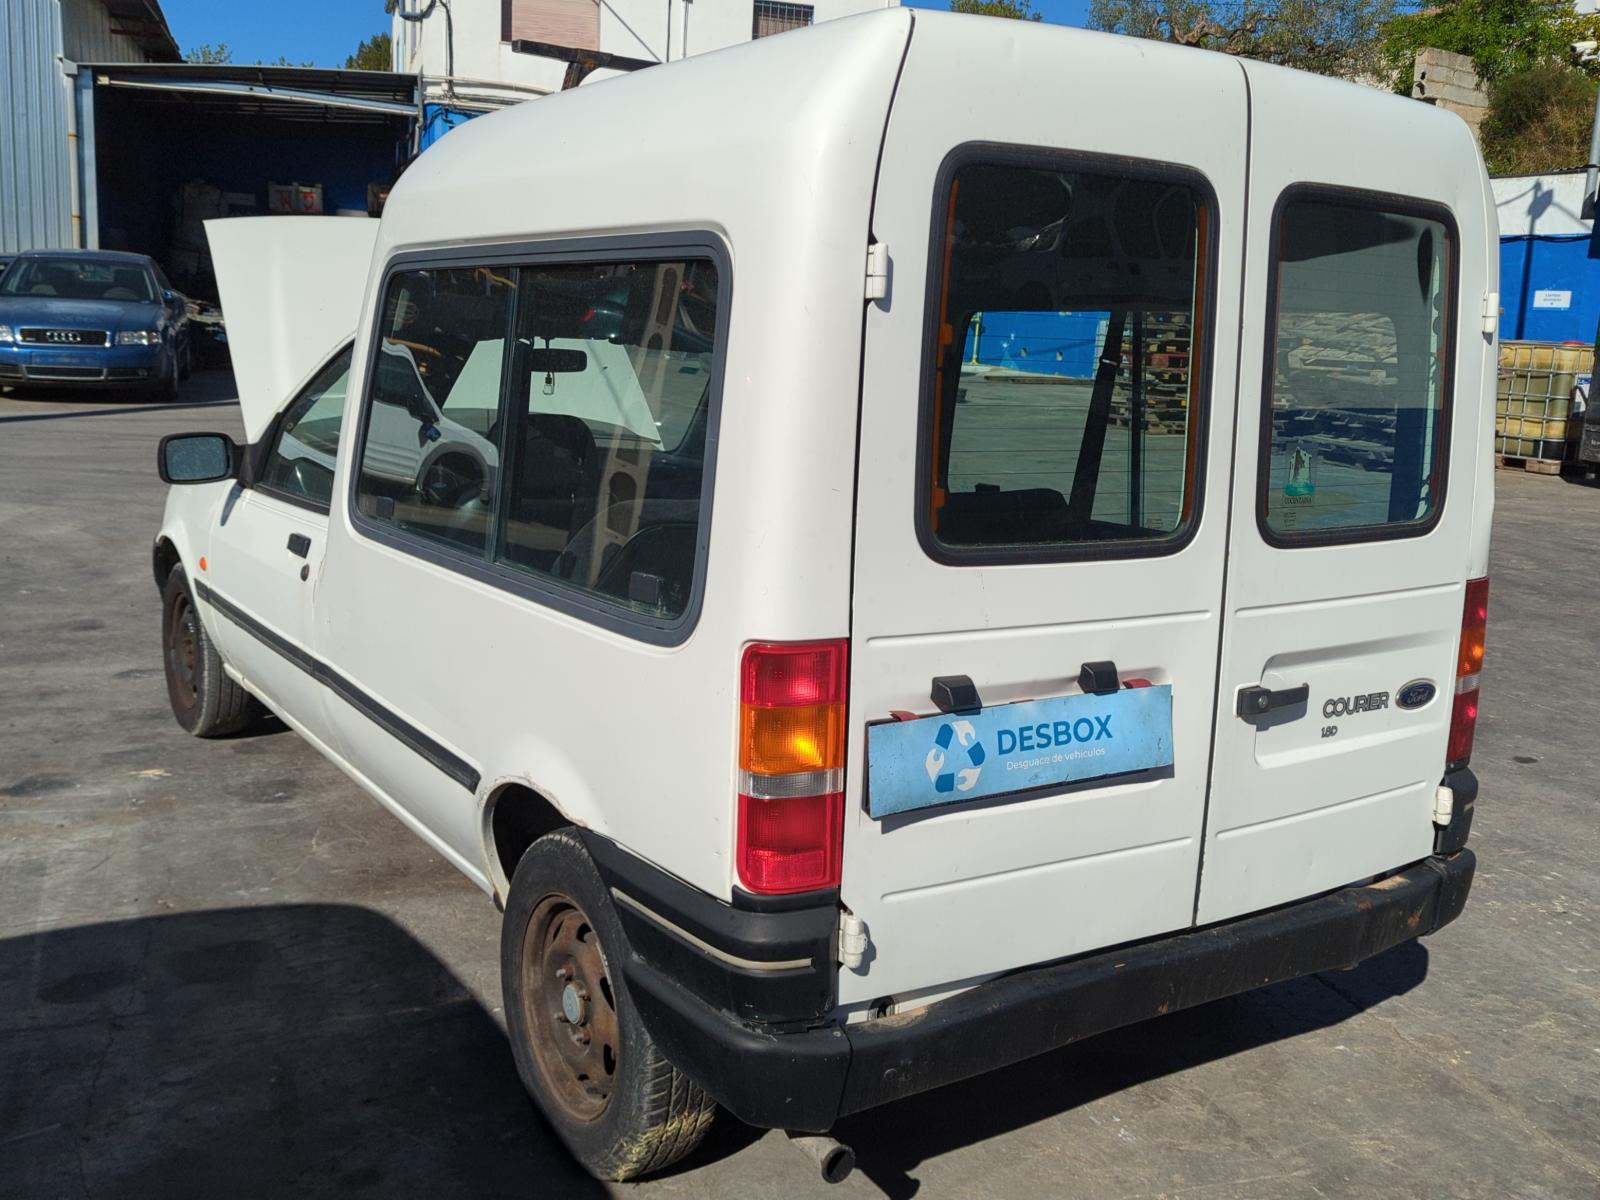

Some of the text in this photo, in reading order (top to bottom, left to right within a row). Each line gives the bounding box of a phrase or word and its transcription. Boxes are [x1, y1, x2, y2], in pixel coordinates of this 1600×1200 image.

[1323, 691, 1390, 719] COURIER
[997, 714, 1113, 756] DESBOX
[1006, 756, 1050, 771] Desguace
[1051, 753, 1063, 763] de
